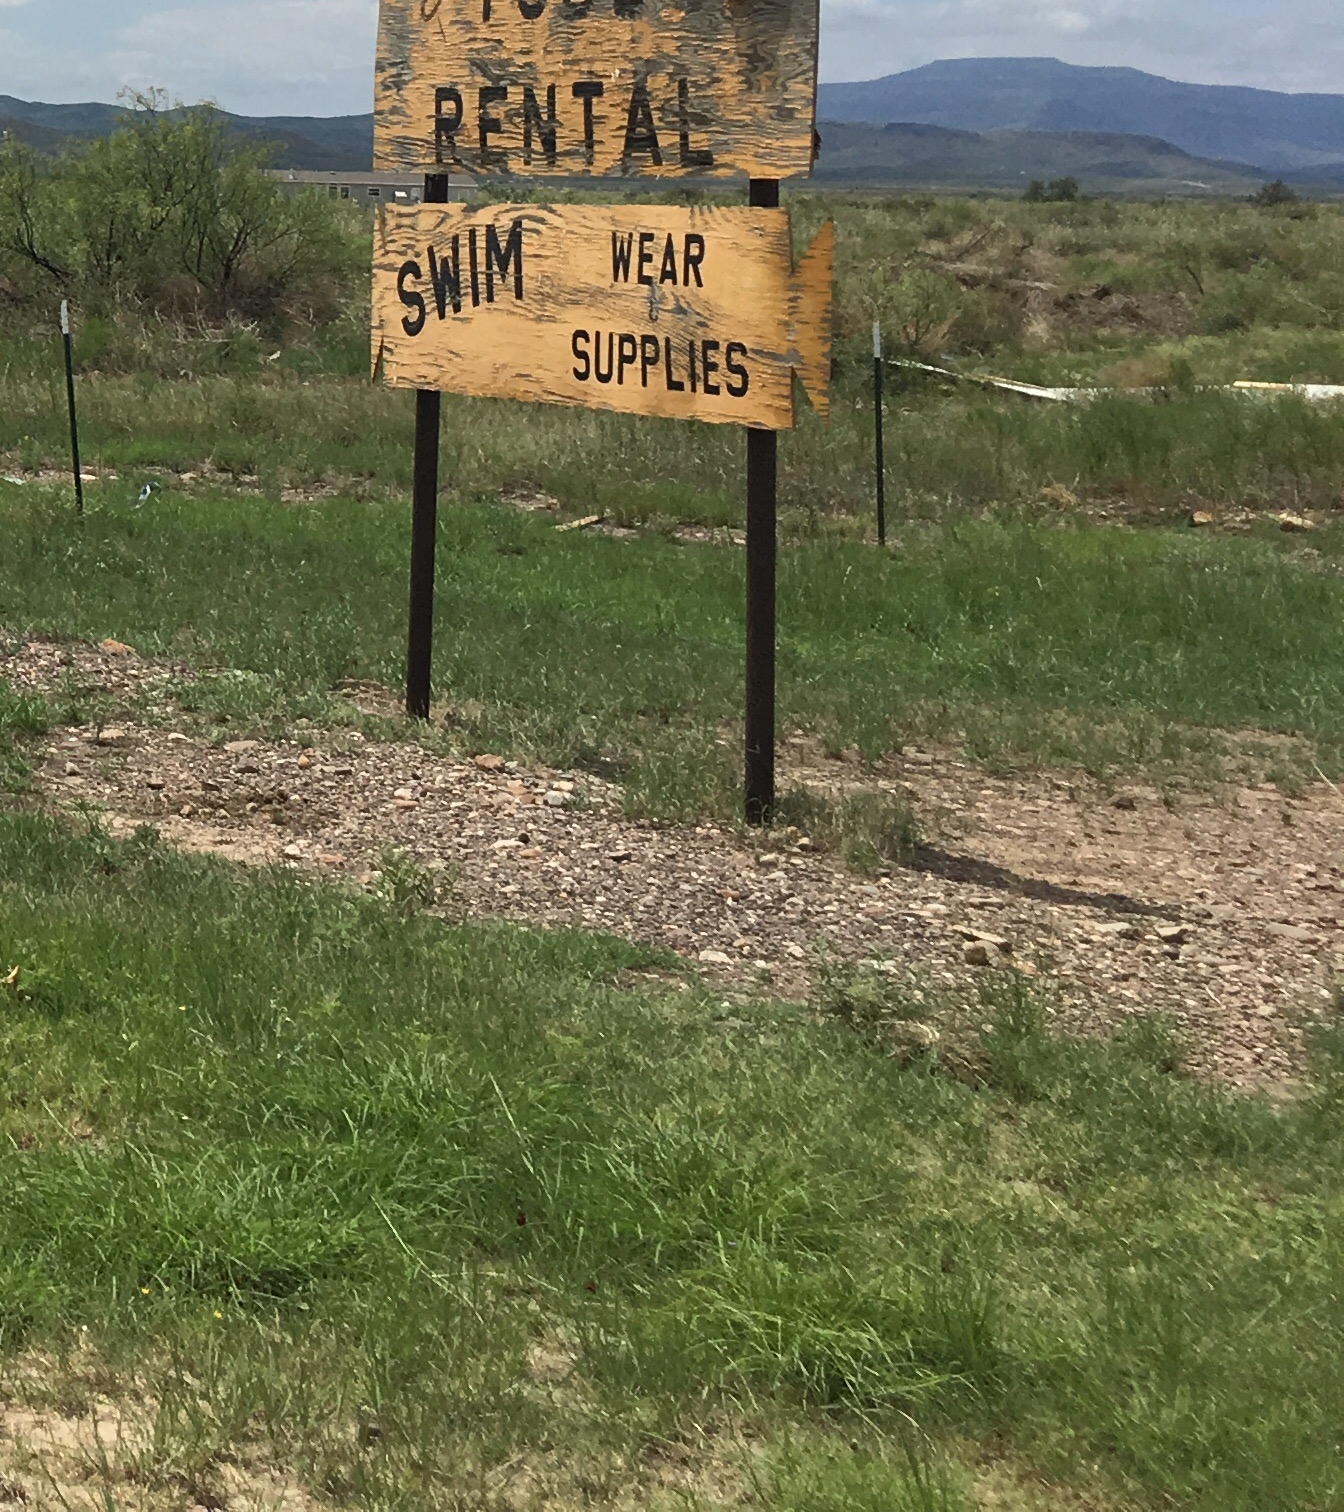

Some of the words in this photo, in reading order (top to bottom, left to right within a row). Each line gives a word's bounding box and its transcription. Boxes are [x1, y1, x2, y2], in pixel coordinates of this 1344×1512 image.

[434, 78, 714, 167] RENTAL
[397, 219, 524, 337] SWIM
[611, 231, 706, 288] WEAR
[571, 329, 750, 398] SUPPLIES
